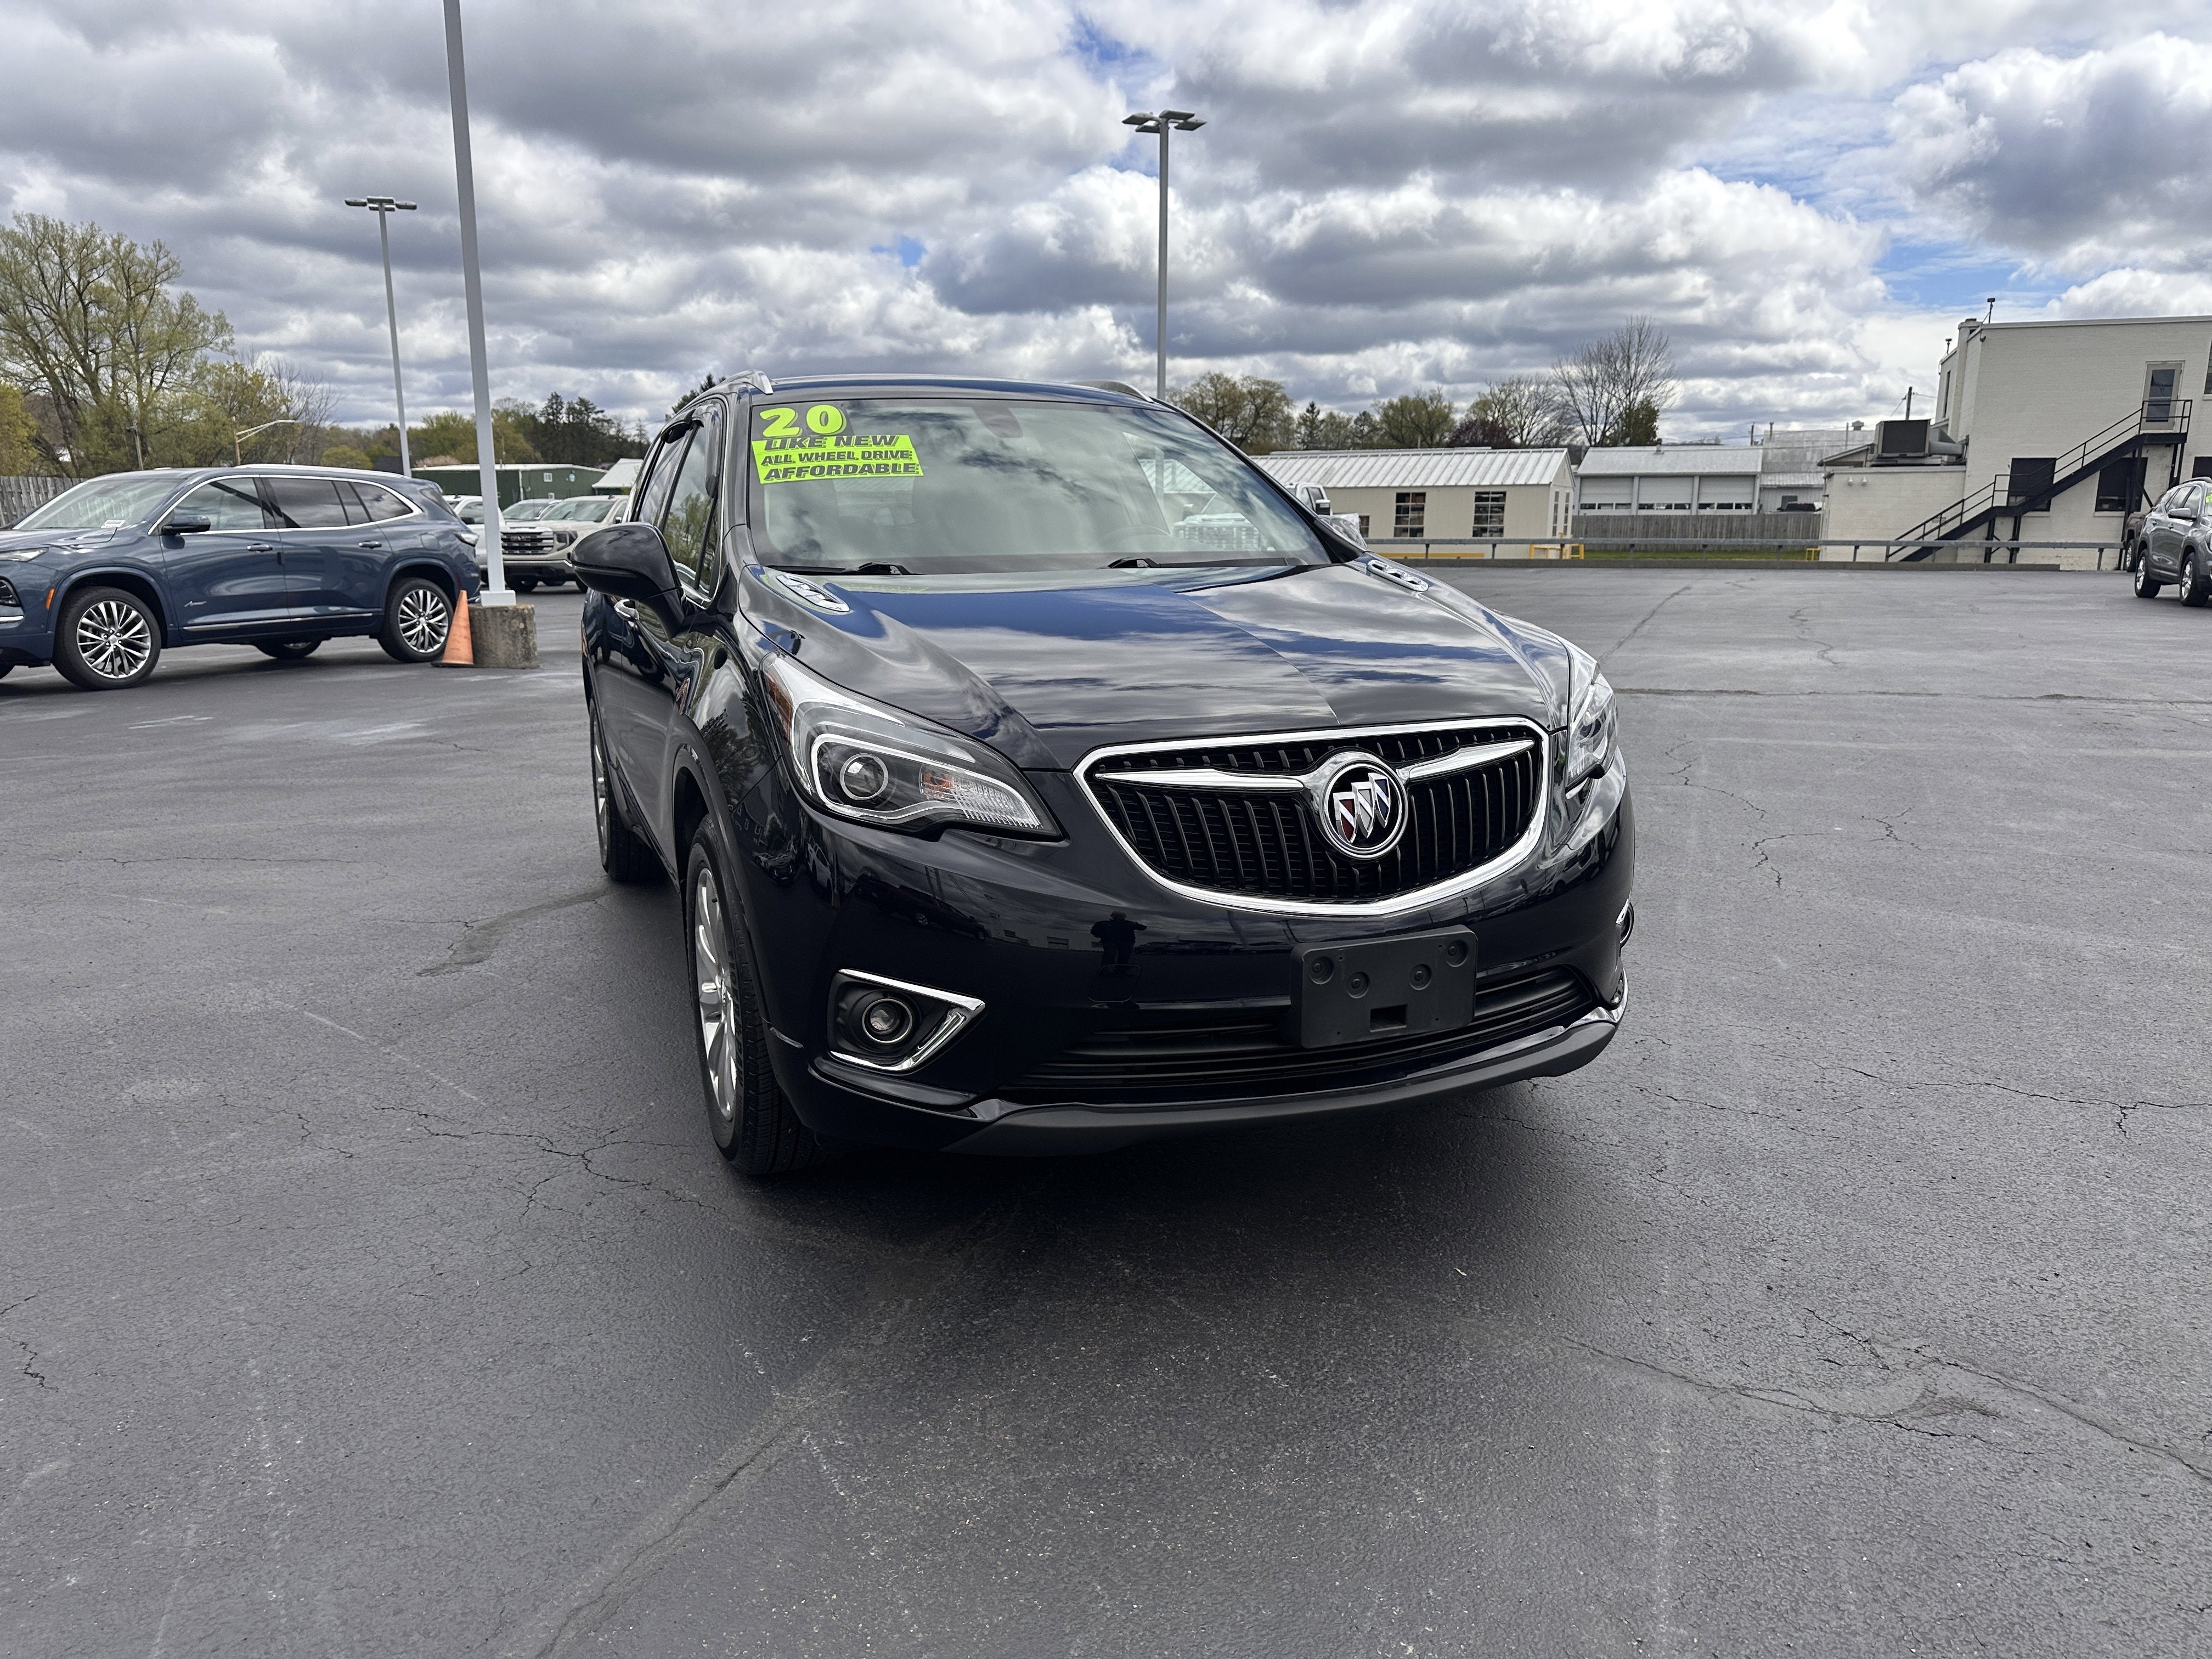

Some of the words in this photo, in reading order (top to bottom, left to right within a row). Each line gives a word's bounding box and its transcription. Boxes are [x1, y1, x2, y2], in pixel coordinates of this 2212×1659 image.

[760, 404, 847, 438] 20
[764, 437, 827, 452] LIKE
[834, 435, 900, 447] NEW
[761, 454, 795, 466] ALL
[798, 450, 859, 462] WHEEL
[861, 450, 912, 460] DRIVE
[764, 462, 919, 481] AFFORDABLE
